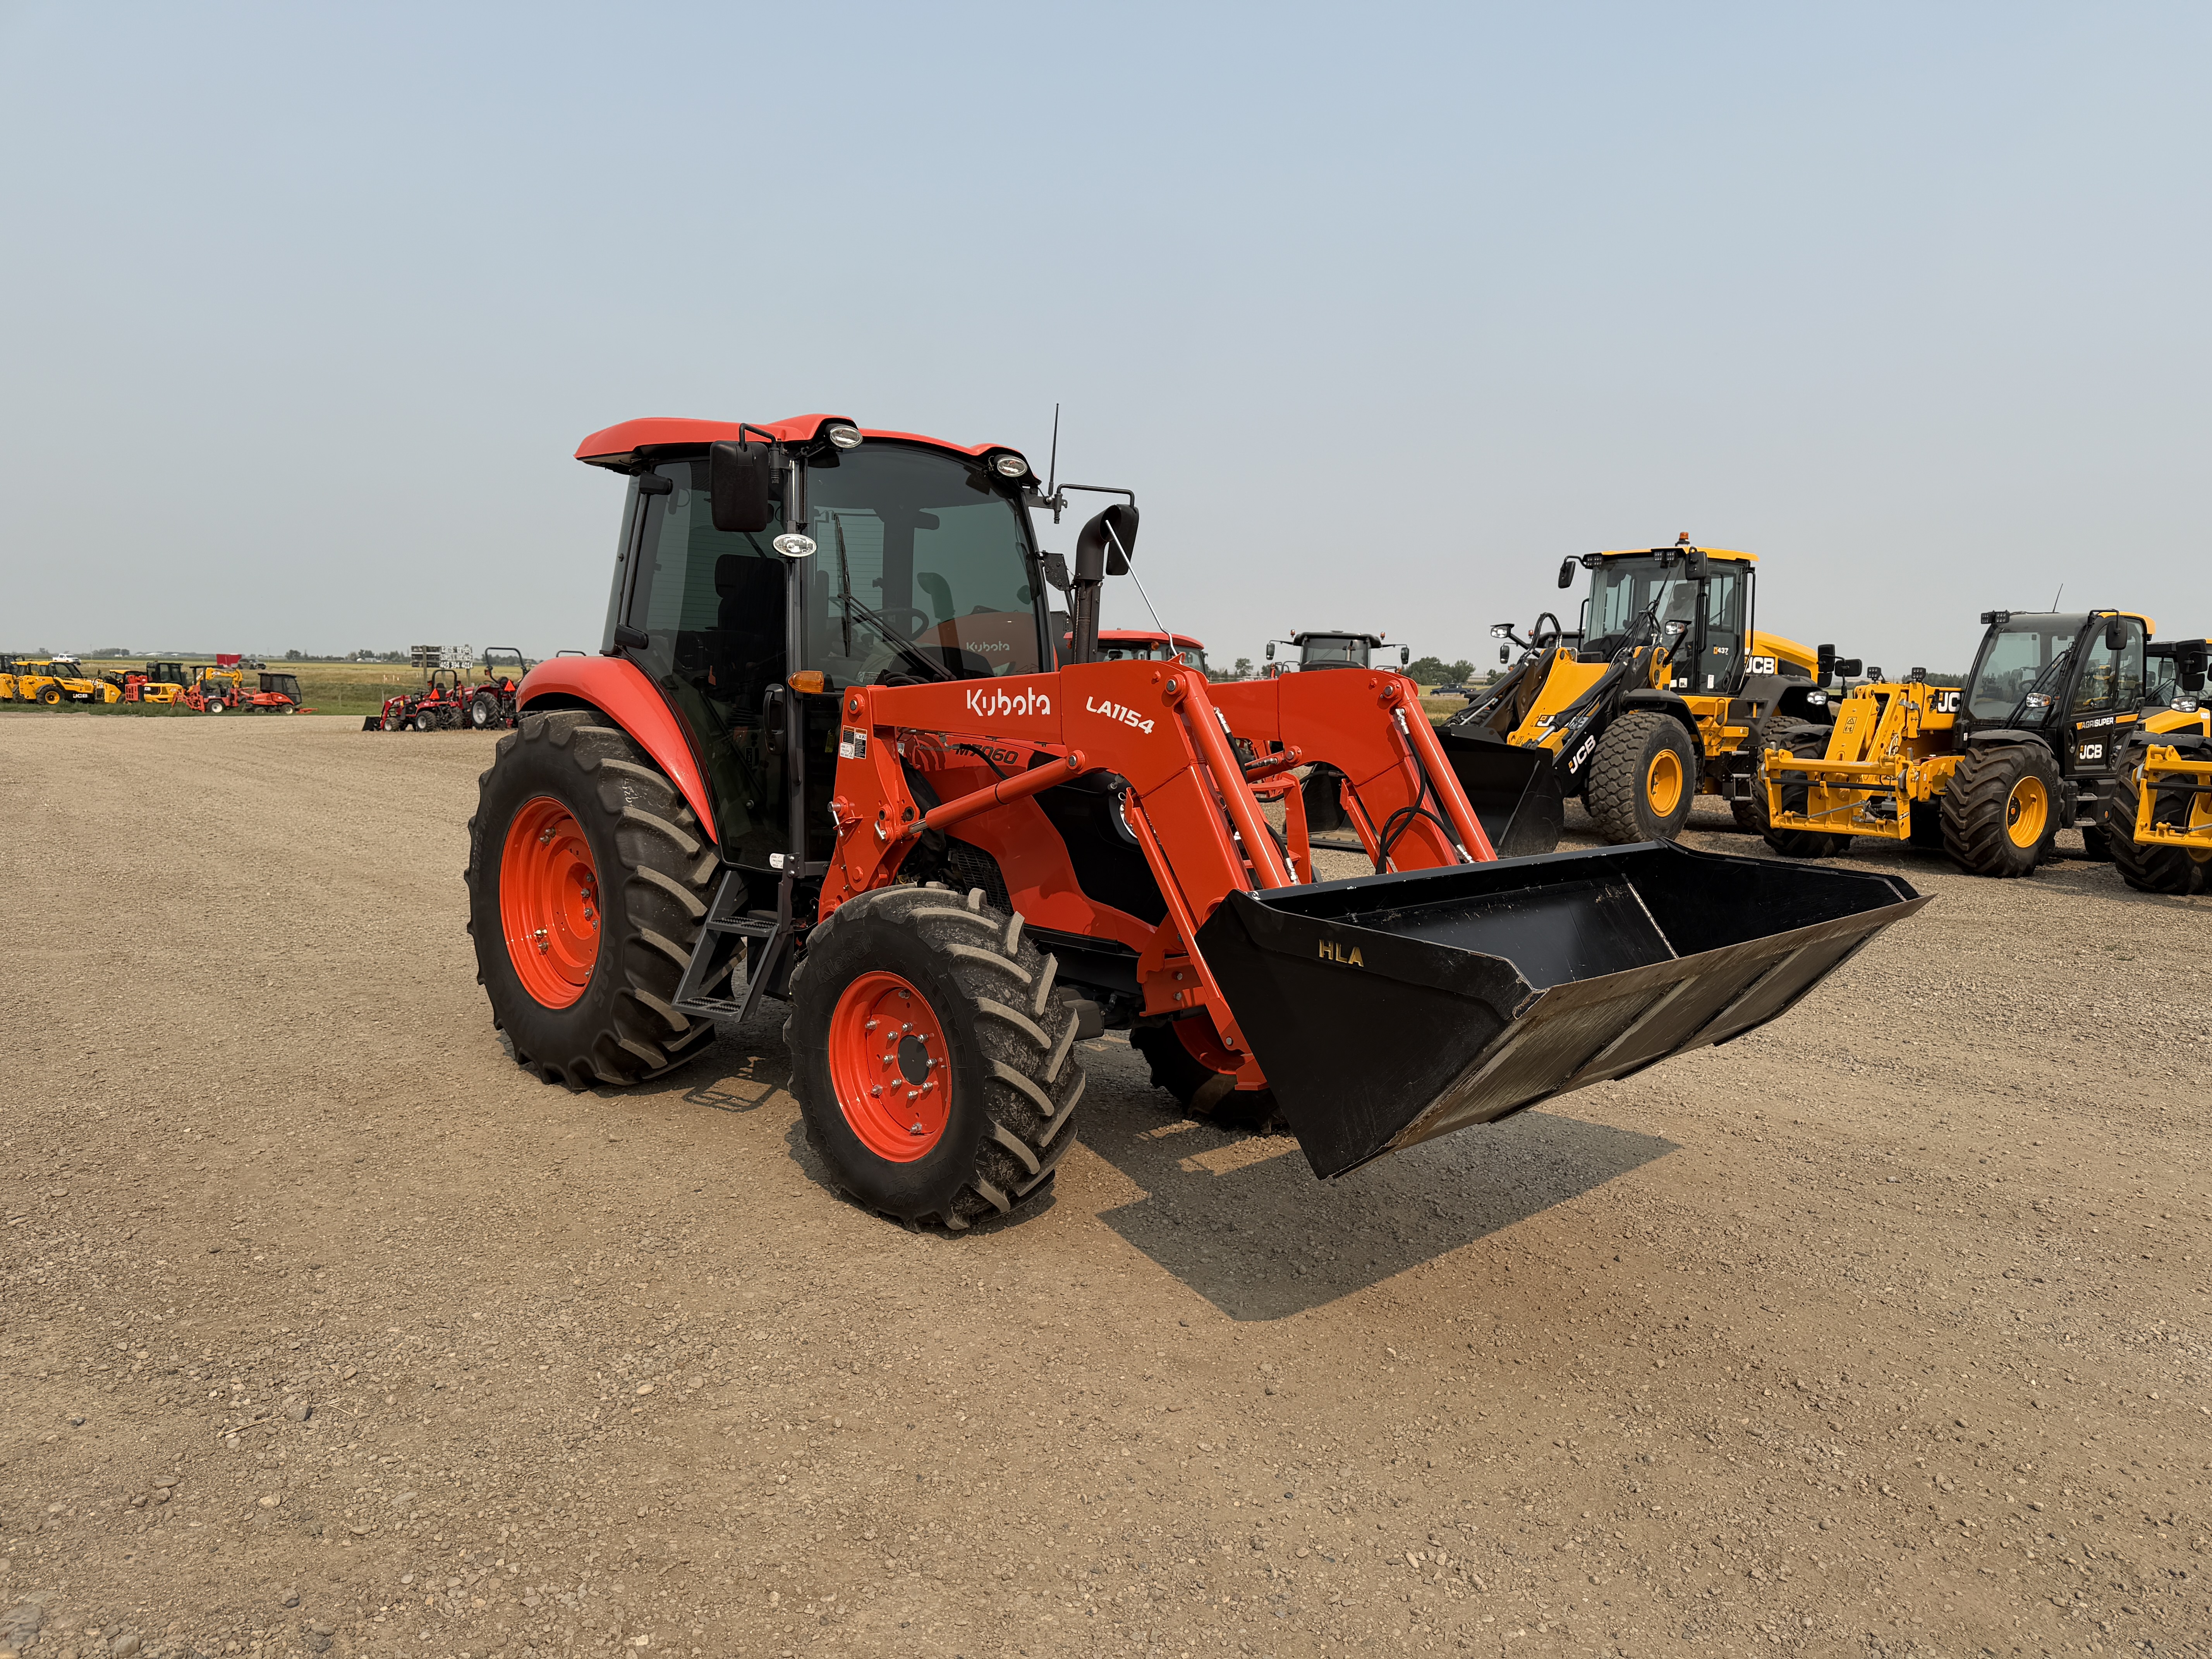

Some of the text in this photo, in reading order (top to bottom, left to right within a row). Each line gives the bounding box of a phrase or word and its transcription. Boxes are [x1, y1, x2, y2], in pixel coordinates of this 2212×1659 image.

[966, 641, 1010, 652] Kubota
[1745, 657, 1774, 674] JCB
[967, 687, 1050, 716] Kubota
[1086, 696, 1155, 734] LA1154
[1938, 692, 1964, 712] JC
[1570, 735, 1596, 774] JCB
[2080, 744, 2102, 759] JCB
[2042, 767, 2057, 797] MICHELIN
[815, 935, 872, 984] Kleber
[1319, 939, 1364, 967] HLA
[920, 965, 969, 1091] FITKER
